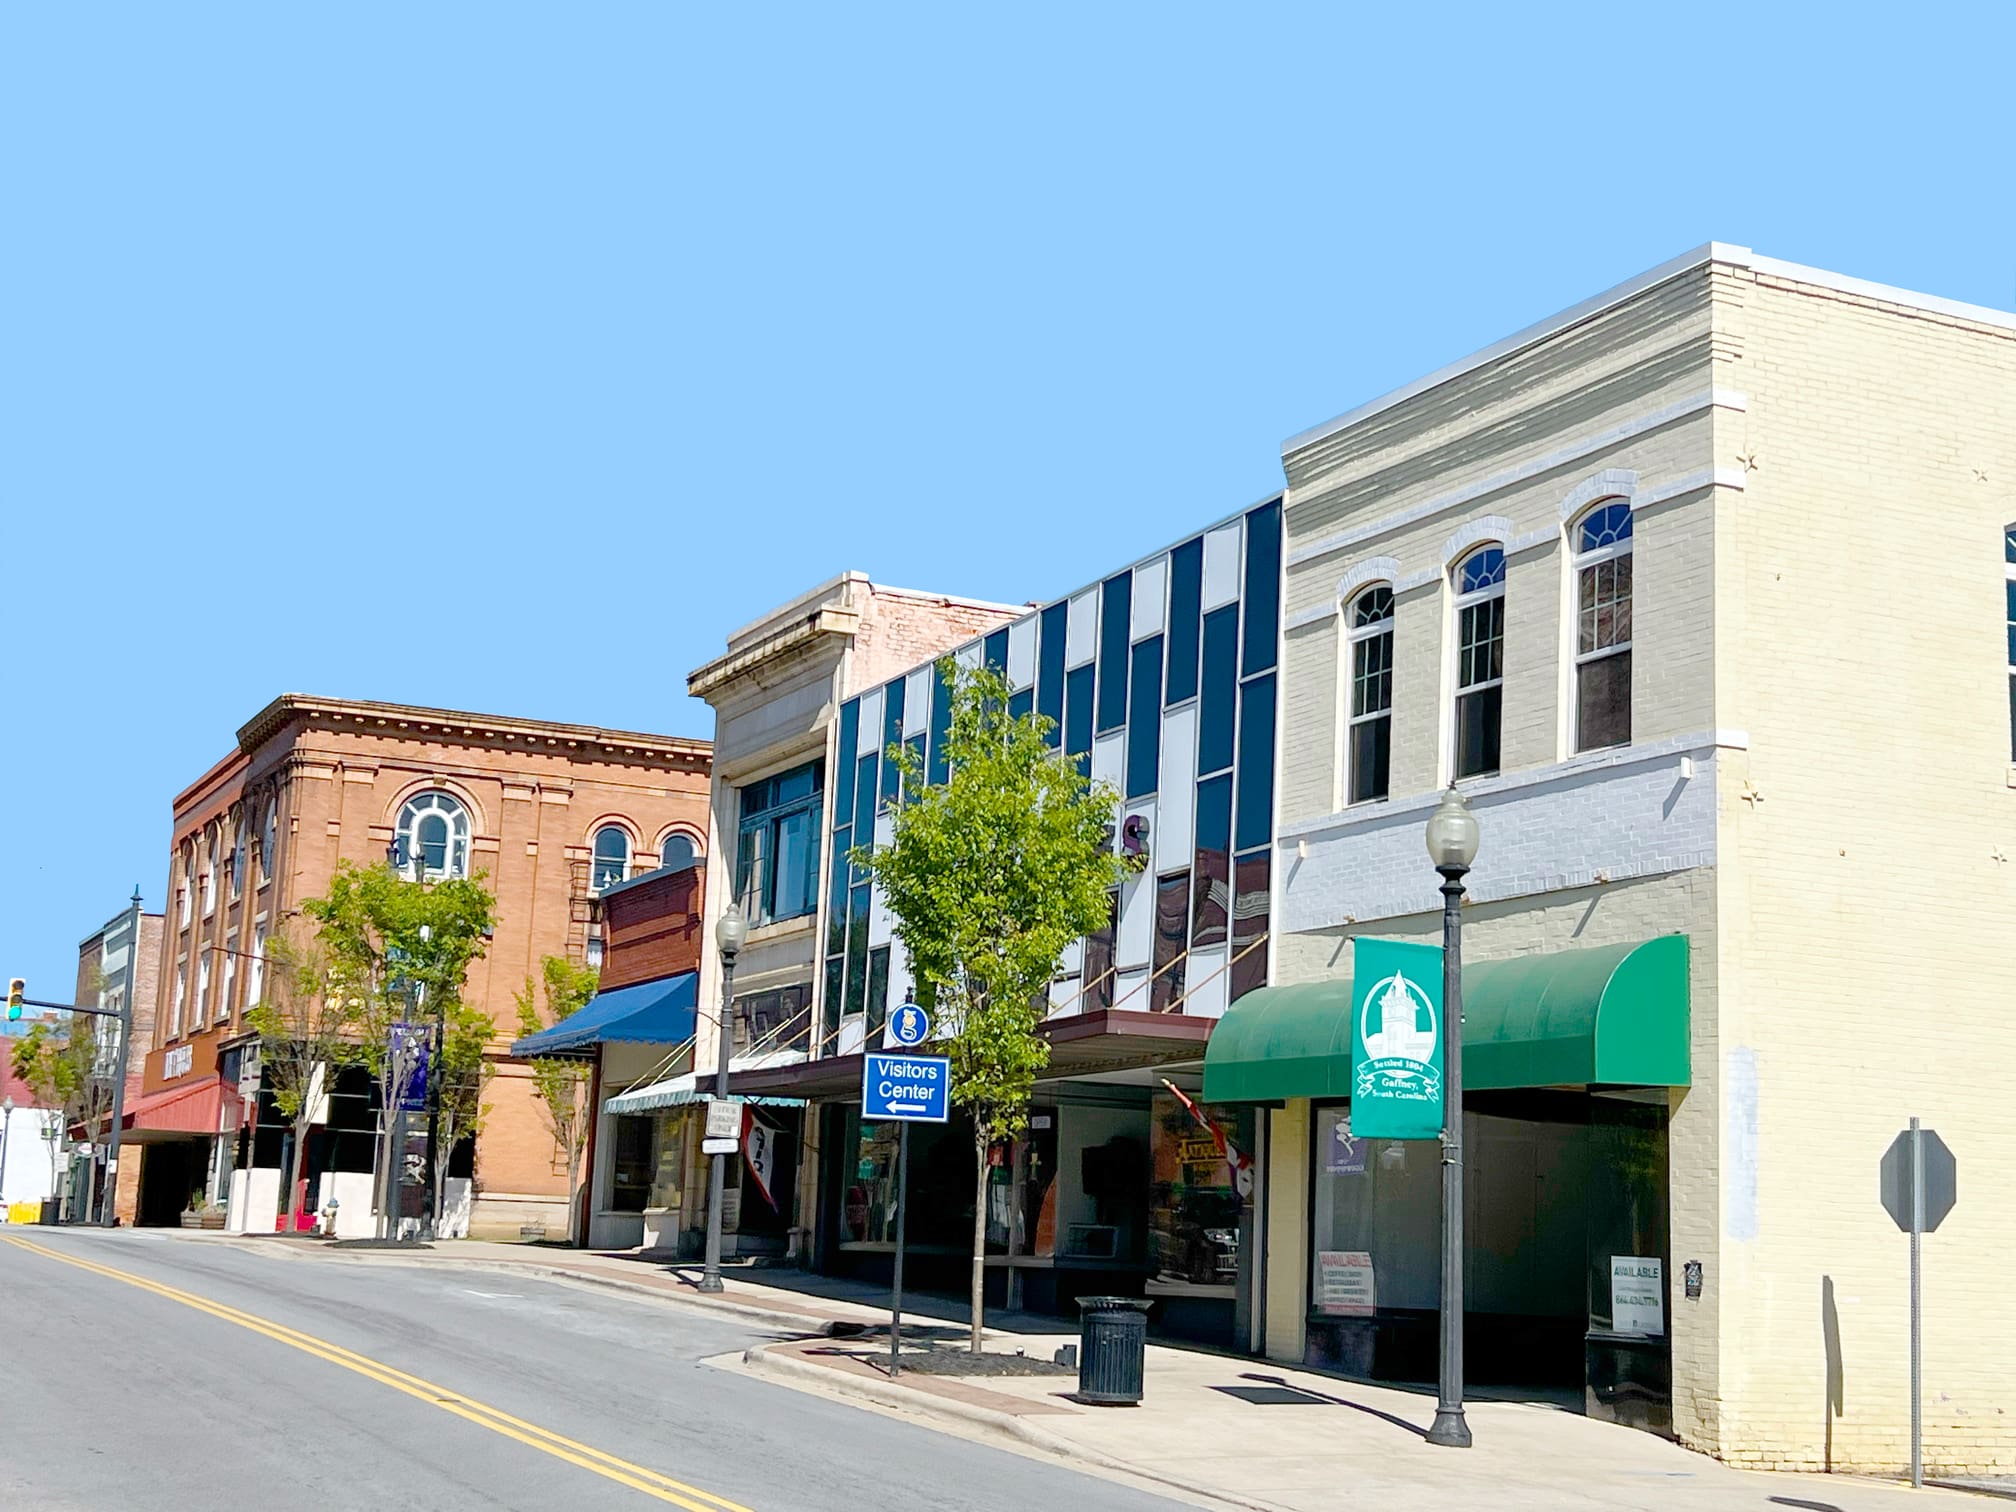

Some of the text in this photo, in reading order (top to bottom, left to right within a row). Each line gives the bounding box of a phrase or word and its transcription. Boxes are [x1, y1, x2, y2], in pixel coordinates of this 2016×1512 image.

[877, 1060, 938, 1080] Visitors
[1373, 1059, 1403, 1069] Settled
[878, 1081, 936, 1100] Center
[1381, 1077, 1419, 1091] Gaffney,
[1372, 1089, 1428, 1101] South Carolina
[1613, 1266, 1659, 1279] AVAILABLE
